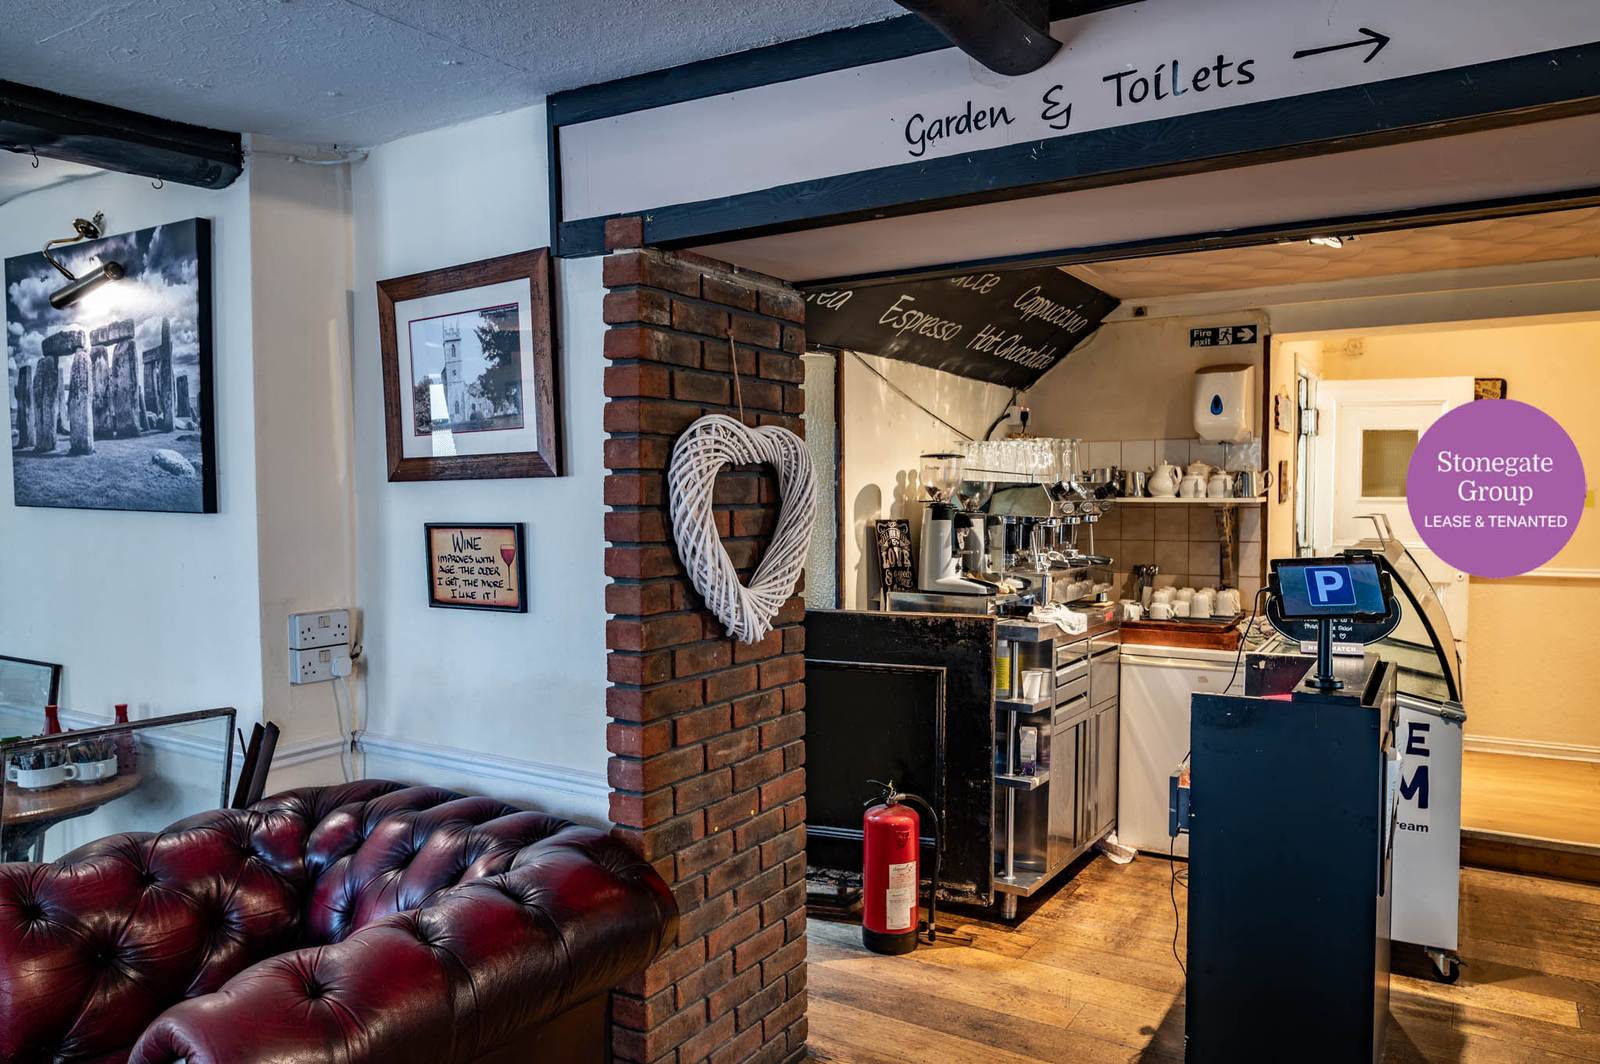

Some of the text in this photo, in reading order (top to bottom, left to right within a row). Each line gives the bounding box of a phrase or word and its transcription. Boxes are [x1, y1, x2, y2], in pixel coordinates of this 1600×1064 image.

[905, 54, 1256, 157] Garden & Toilets
[1012, 285, 1089, 335] Cappuccino
[878, 294, 963, 342] Espresso
[965, 324, 1057, 370] Hot Chocolate
[1194, 338, 1211, 347] exit
[437, 554, 495, 565] IMPROVES WITH
[458, 566, 475, 575] THE
[477, 566, 501, 577] OLDER
[437, 577, 443, 586] I
[462, 579, 479, 588] THE
[481, 579, 504, 589] MORE
[1314, 570, 1344, 602] P
[451, 589, 457, 599] I
[458, 591, 477, 599] LIKE
[1396, 820, 1429, 833] eam
